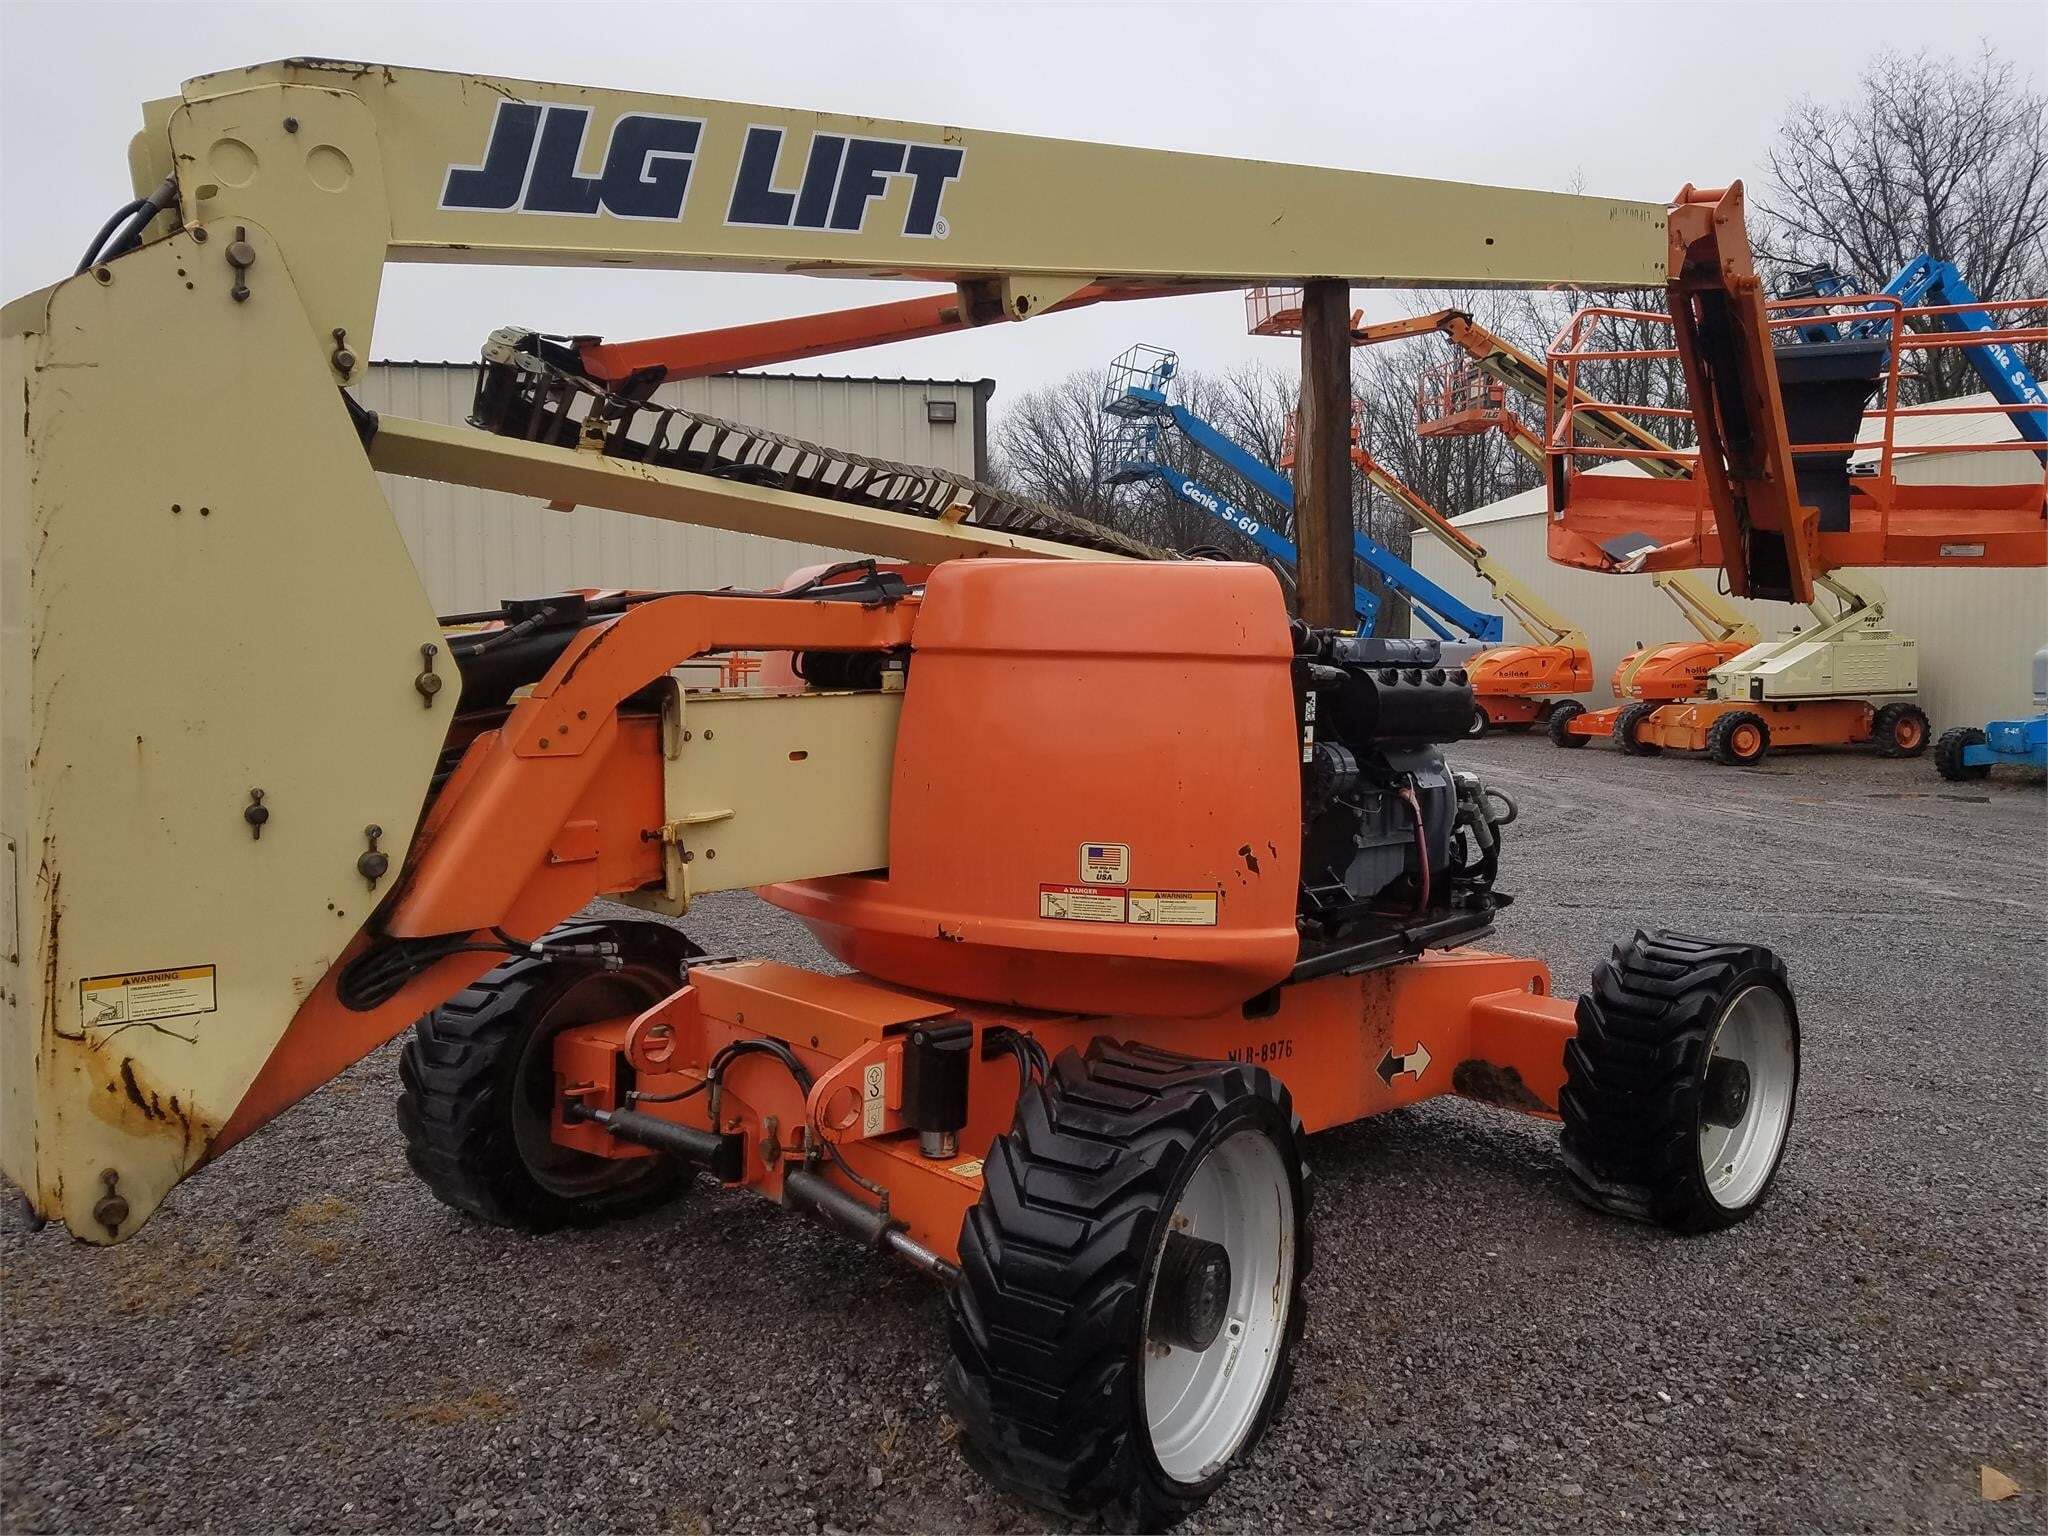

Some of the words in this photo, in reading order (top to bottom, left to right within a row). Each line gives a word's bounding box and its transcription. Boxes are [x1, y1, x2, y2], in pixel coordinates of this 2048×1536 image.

[438, 99, 707, 222] JLG
[723, 123, 968, 238] LIFT
[1182, 481, 1218, 513] Genie
[1221, 506, 1259, 535] S-60
[1096, 873, 1113, 881] USA
[1160, 892, 1193, 900] WARNING
[131, 972, 179, 983] WARNING
